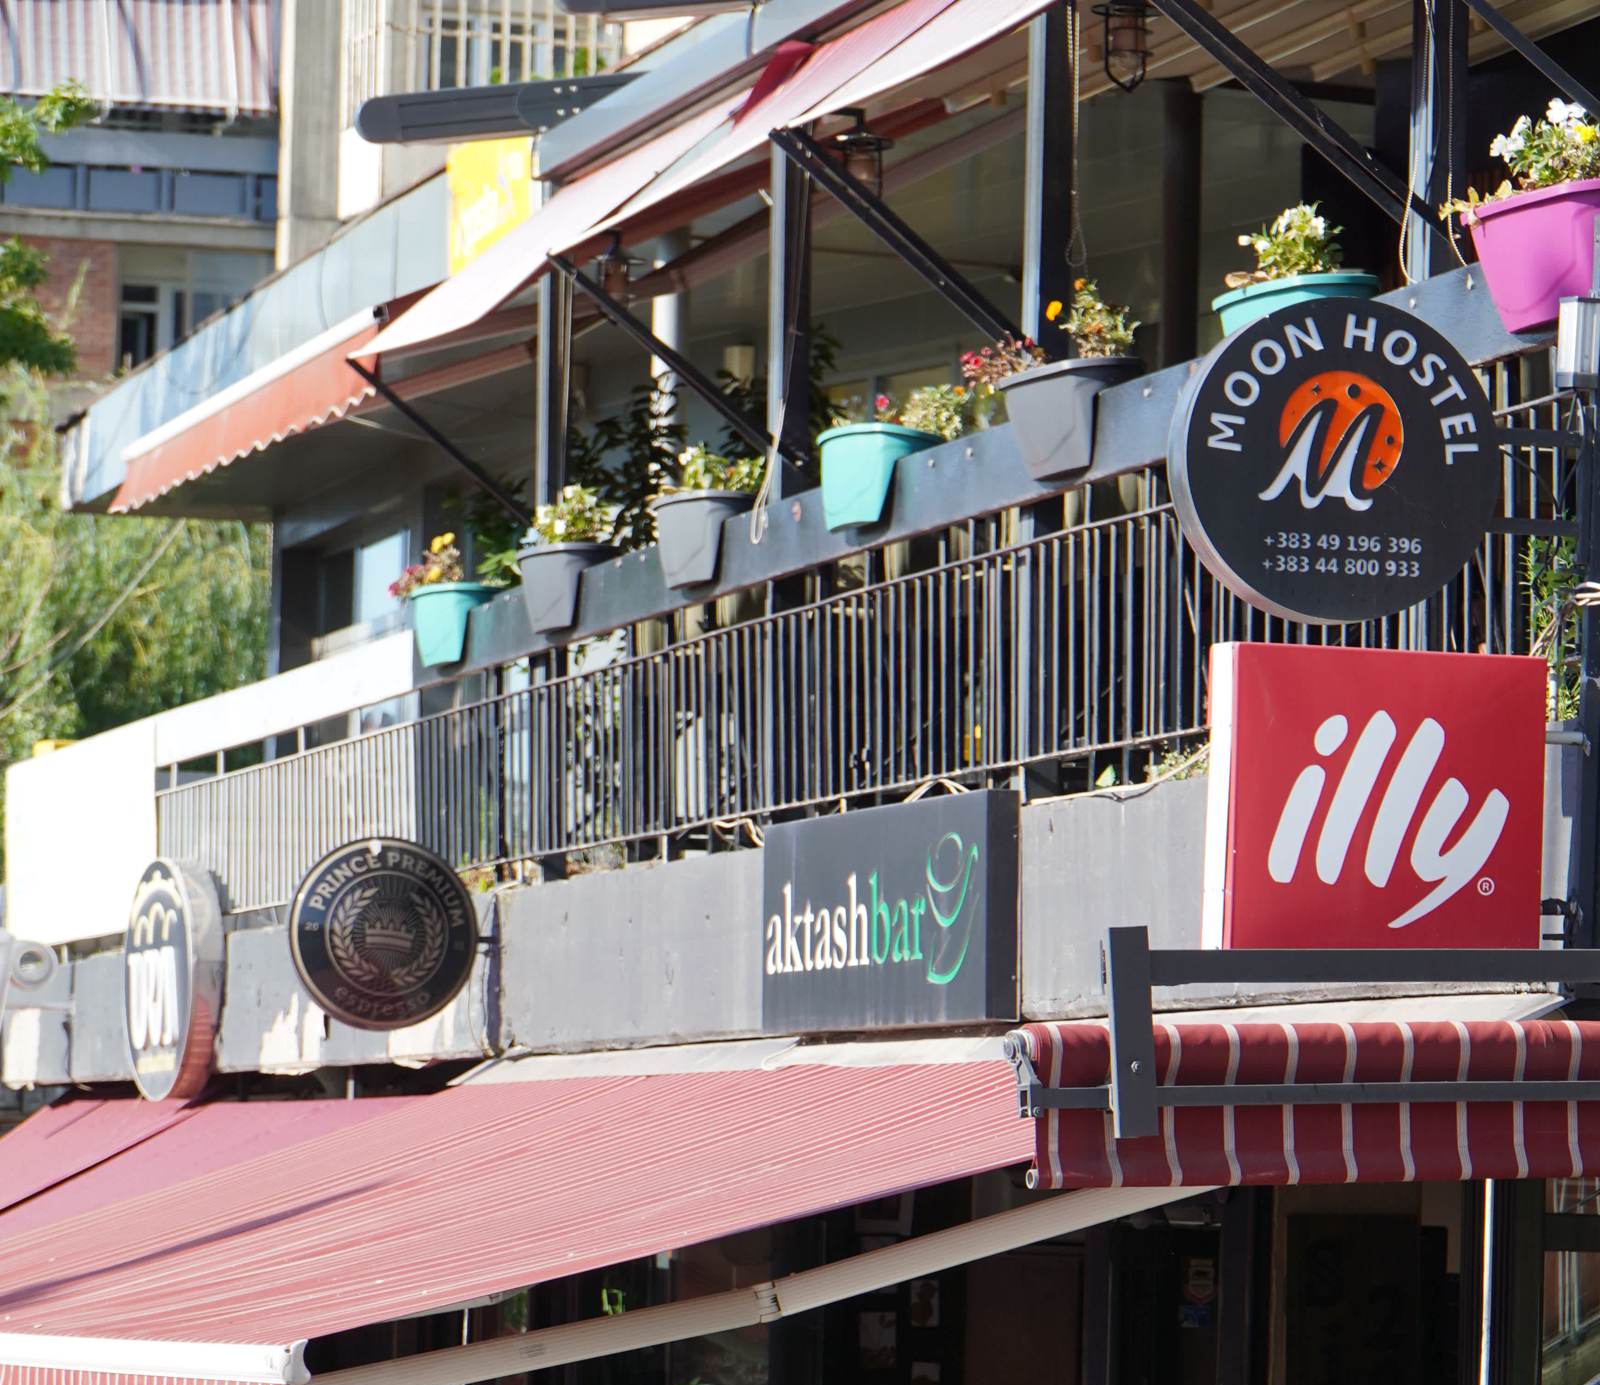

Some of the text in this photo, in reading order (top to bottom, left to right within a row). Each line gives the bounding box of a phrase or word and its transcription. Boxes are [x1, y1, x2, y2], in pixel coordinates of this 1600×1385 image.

[1207, 313, 1480, 466] MOON HOSTEL
[1262, 555, 1420, 577] +383 44 800 933
[1263, 532, 1422, 554] +383 49 196 396
[1268, 710, 1510, 928] illy
[308, 852, 465, 928] PRINCE PREMIUM
